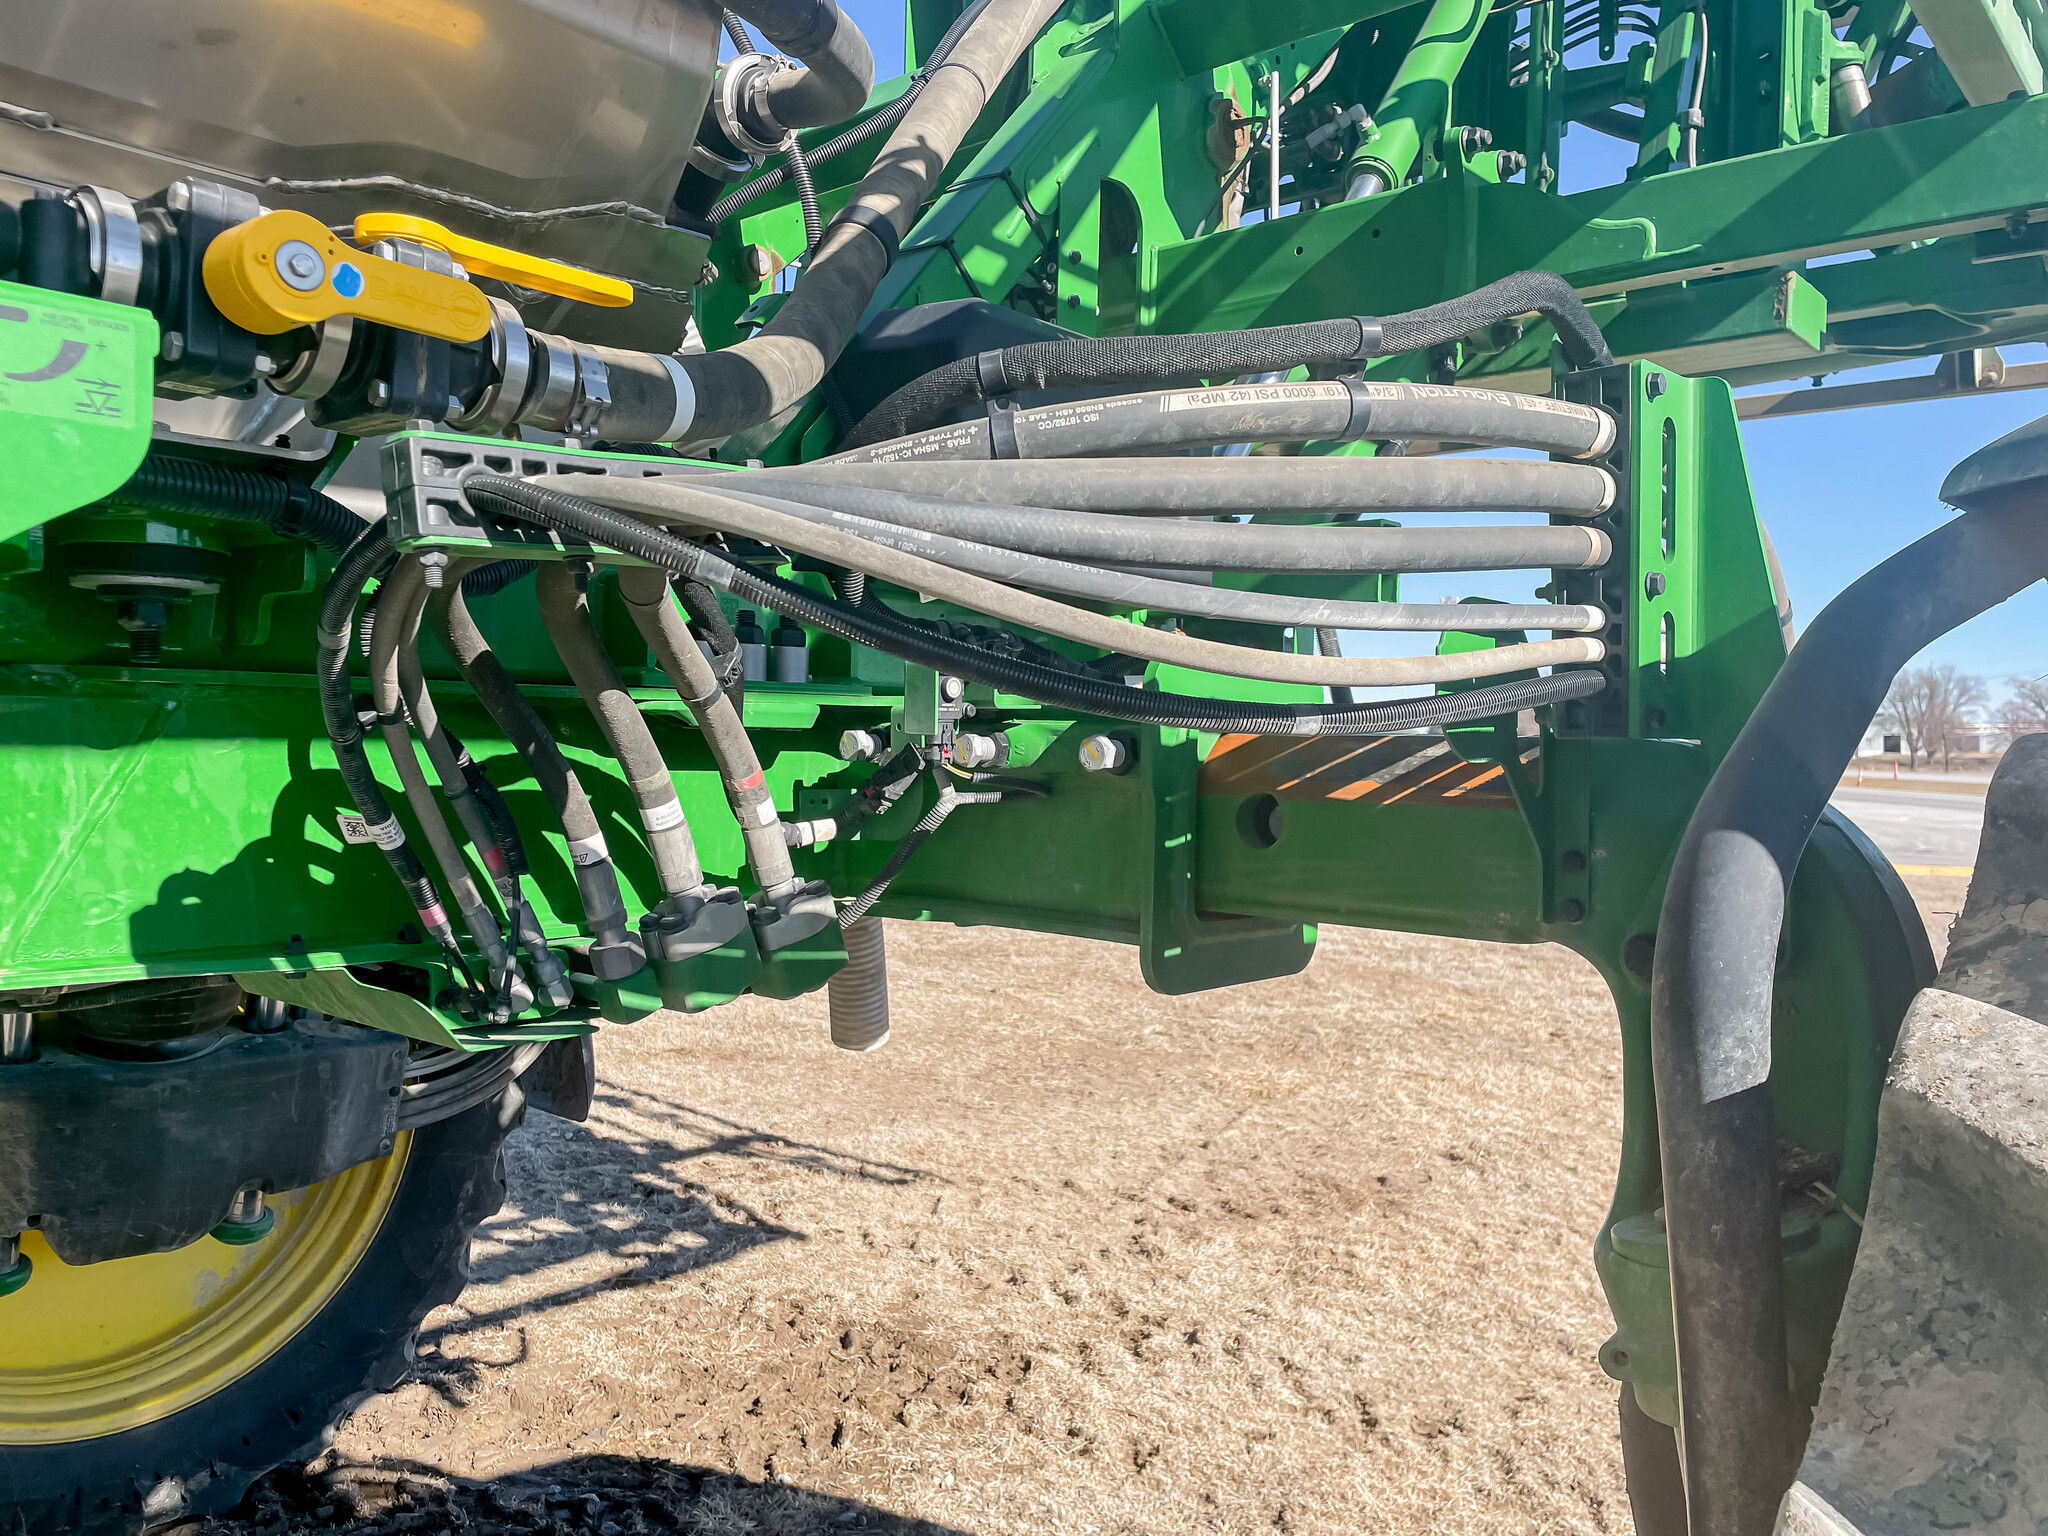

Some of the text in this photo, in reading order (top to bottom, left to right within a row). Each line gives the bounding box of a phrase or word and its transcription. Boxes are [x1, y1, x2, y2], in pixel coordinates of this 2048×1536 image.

[1187, 391, 1226, 406] MPa)
[1228, 390, 1251, 401] (42
[1255, 388, 1282, 400] PSI
[1283, 387, 1315, 398] 6000
[1410, 386, 1512, 407] EVOLUTION
[1105, 398, 1143, 408] exceeds
[1055, 408, 1073, 417] 4SH
[1037, 412, 1100, 430] ISO 18752/CC
[928, 431, 950, 443] TYPE
[953, 428, 966, 437] HF
[947, 435, 971, 448] FRAS
[913, 441, 940, 455] MSHA
